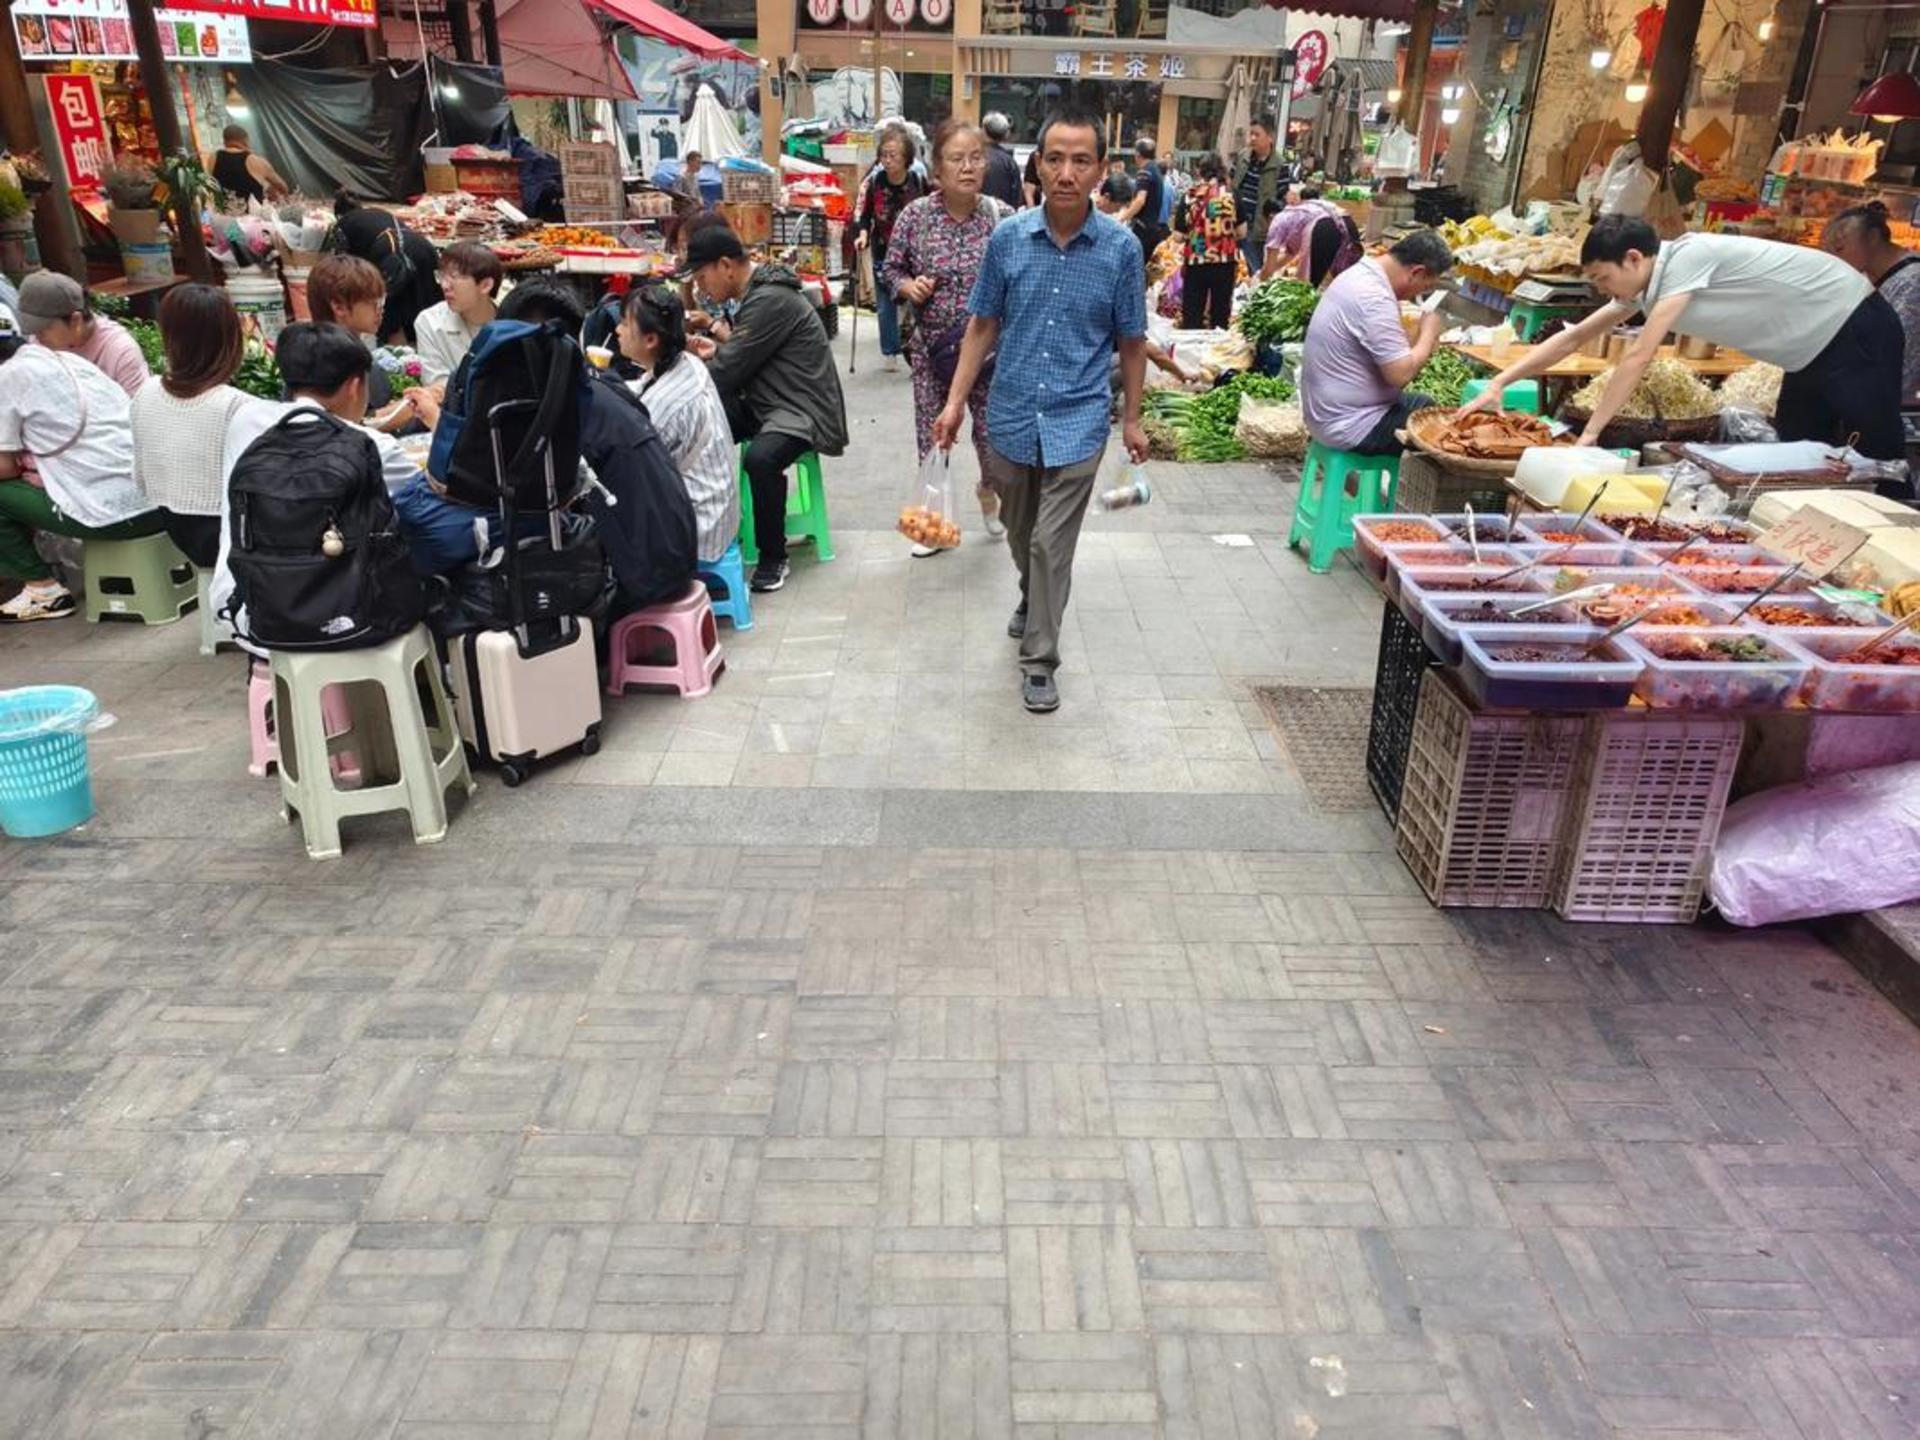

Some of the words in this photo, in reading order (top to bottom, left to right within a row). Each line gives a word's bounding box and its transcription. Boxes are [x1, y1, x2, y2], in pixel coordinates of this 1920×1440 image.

[814, 0, 942, 17] MIAO
[1055, 51, 1186, 78] 霸王茶姬
[59, 81, 101, 181] 包邮
